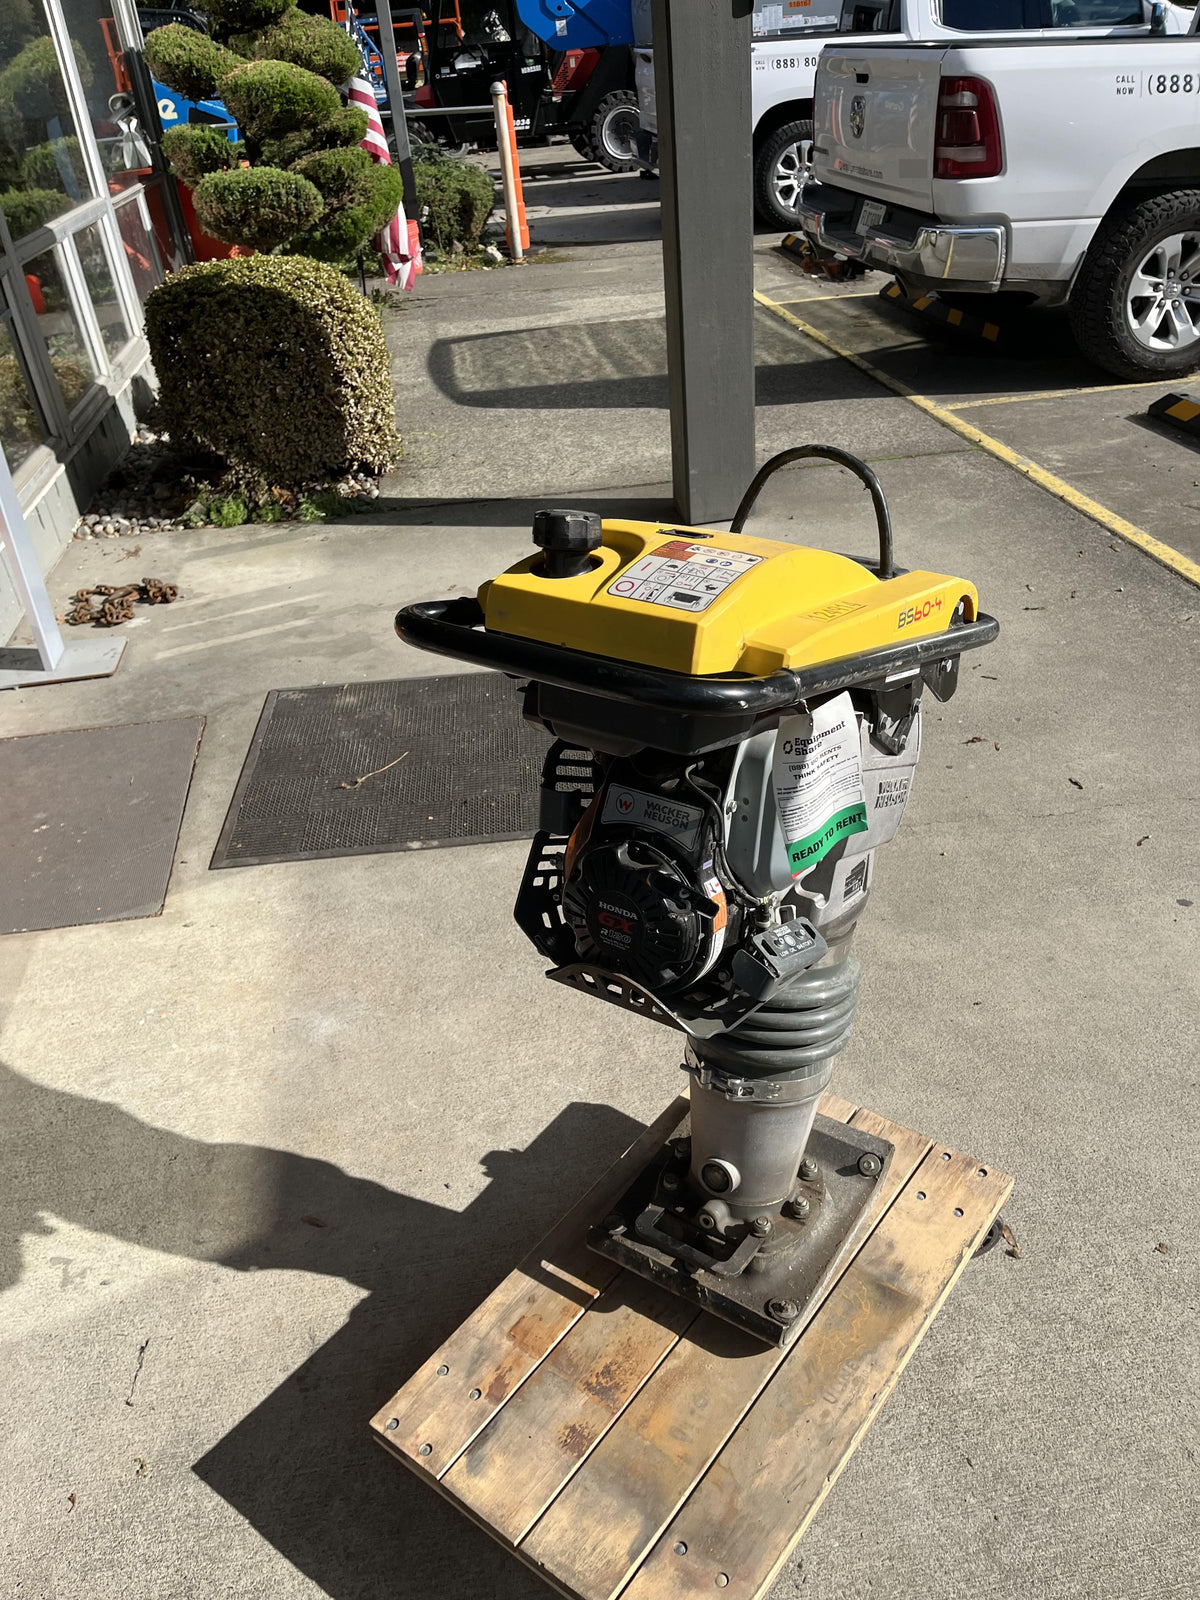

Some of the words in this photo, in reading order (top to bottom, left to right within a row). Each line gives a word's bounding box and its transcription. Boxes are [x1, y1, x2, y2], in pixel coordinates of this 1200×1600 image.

[771, 58, 800, 70] (888)
[804, 56, 817, 67] 80
[1115, 75, 1135, 83] CALL
[1116, 87, 1134, 95] NOW
[898, 597, 942, 629] BS60-4
[794, 721, 846, 748] Equipment
[794, 741, 822, 756] Share
[793, 769, 816, 780] THINK
[816, 754, 840, 769] SAFETY
[643, 809, 689, 830] NEUSON
[646, 800, 690, 821] WACKER
[792, 838, 825, 862] READY
[824, 827, 835, 842] TO
[836, 812, 863, 831] RENT
[598, 901, 639, 921] HONDA
[598, 911, 637, 935] GX
